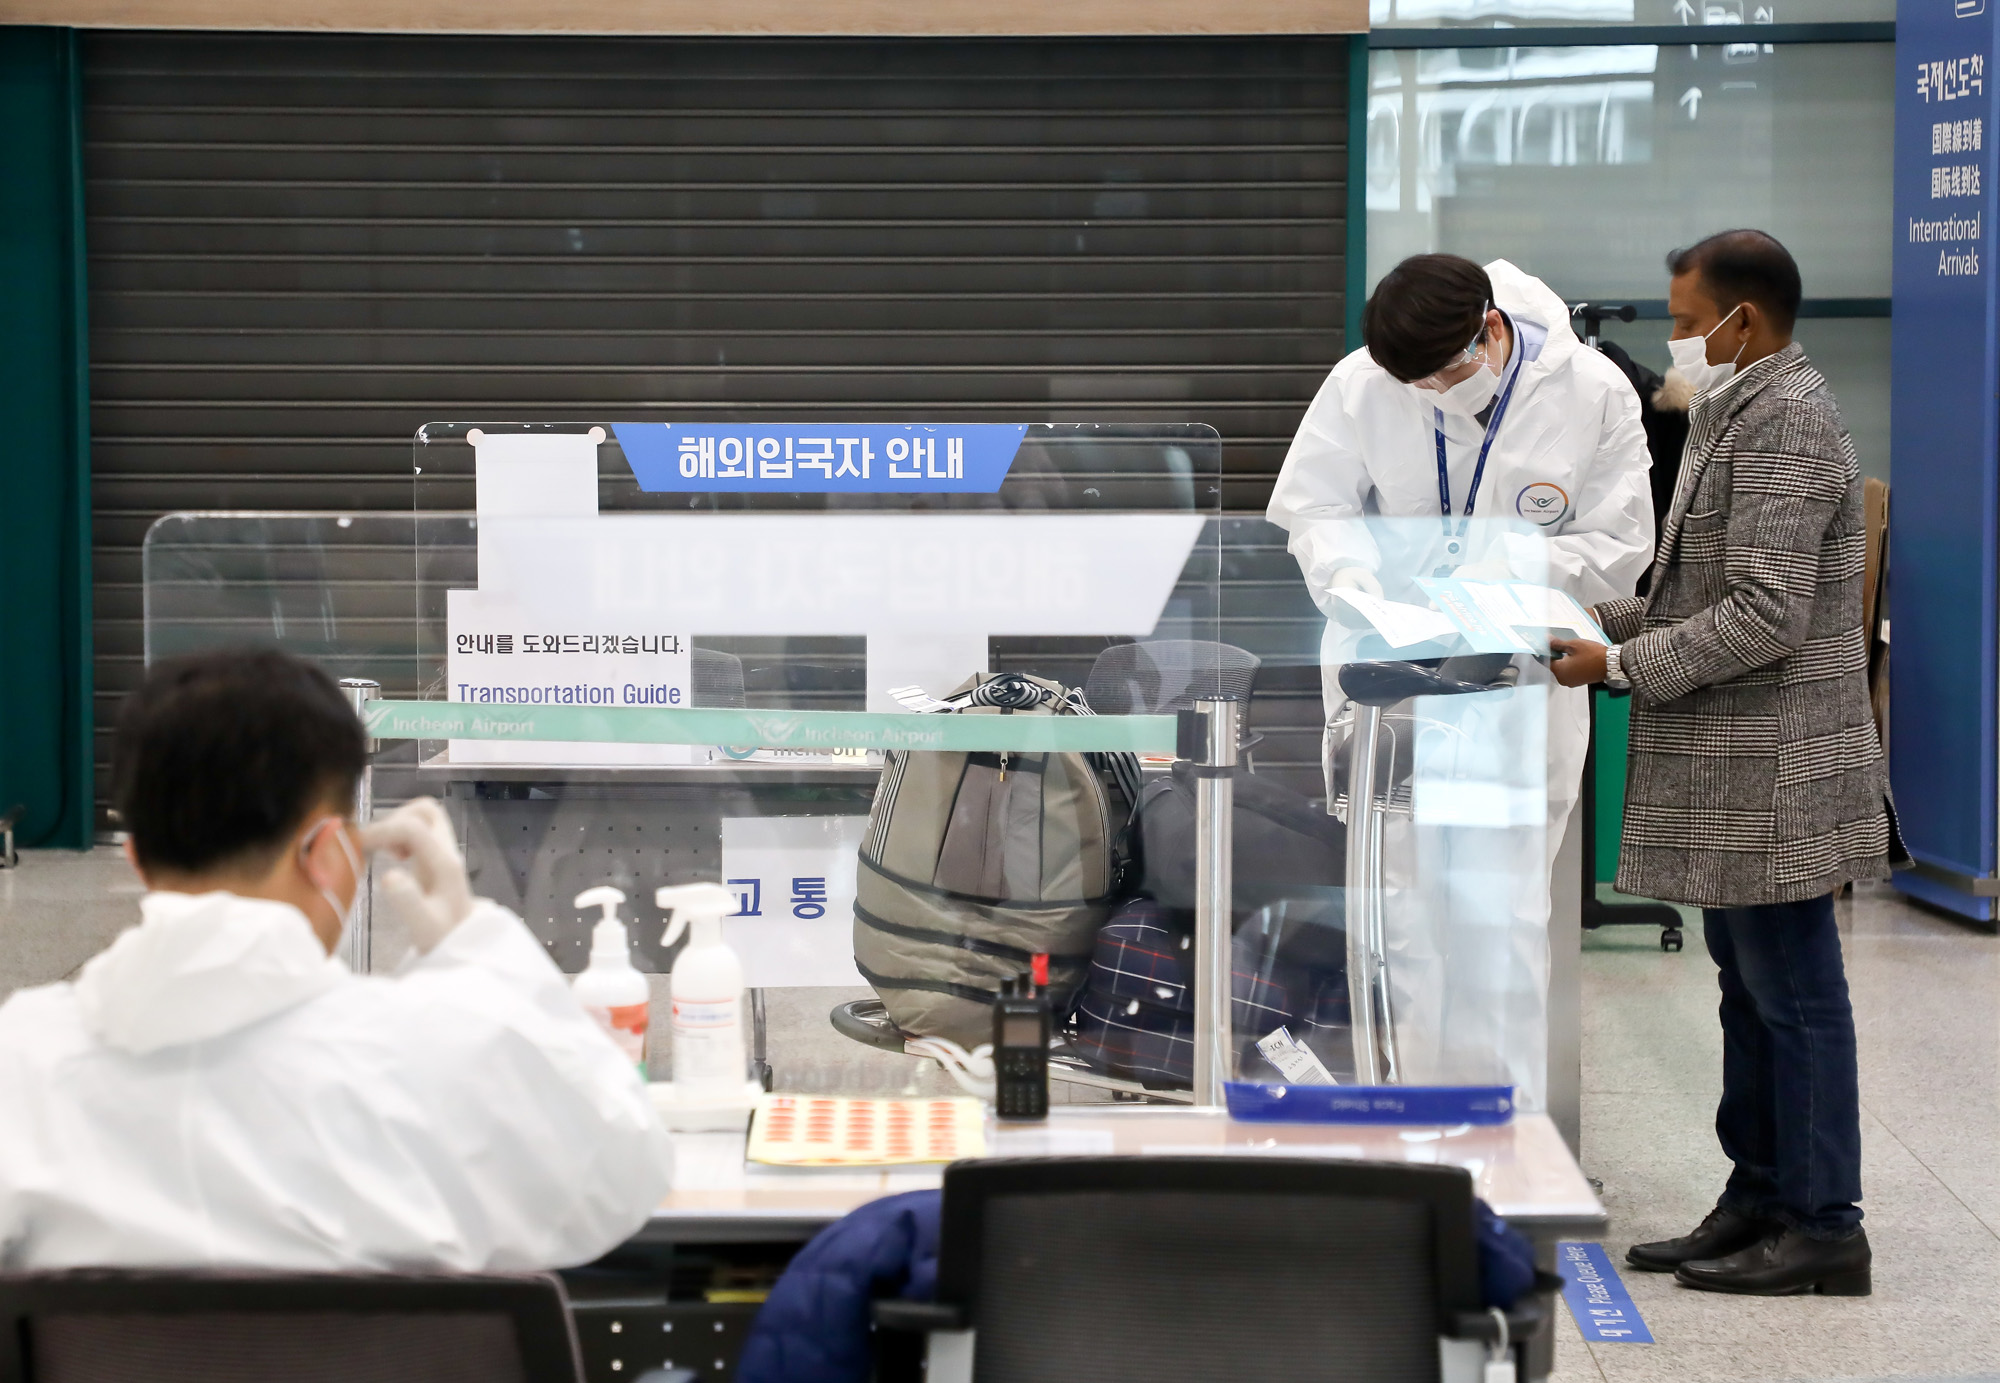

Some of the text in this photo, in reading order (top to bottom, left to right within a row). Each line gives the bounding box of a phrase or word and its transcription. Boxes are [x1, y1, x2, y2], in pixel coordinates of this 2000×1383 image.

[1917, 53, 1984, 103] 국제선도착
[1931, 164, 1981, 199] 国际线到达
[1909, 211, 1980, 243] International
[1938, 247, 1979, 276] Arrivals
[678, 437, 964, 479] 해외입국자 안내
[456, 634, 684, 655] 안내를 도와드리겠습니다.
[458, 683, 682, 705] Transportation Guide
[393, 716, 536, 735] Incheon Airport
[805, 726, 944, 745] Incheon Airport
[1565, 1246, 1590, 1262] Here
[1574, 1262, 1605, 1283] Queue
[1586, 1283, 1614, 1304] Please
